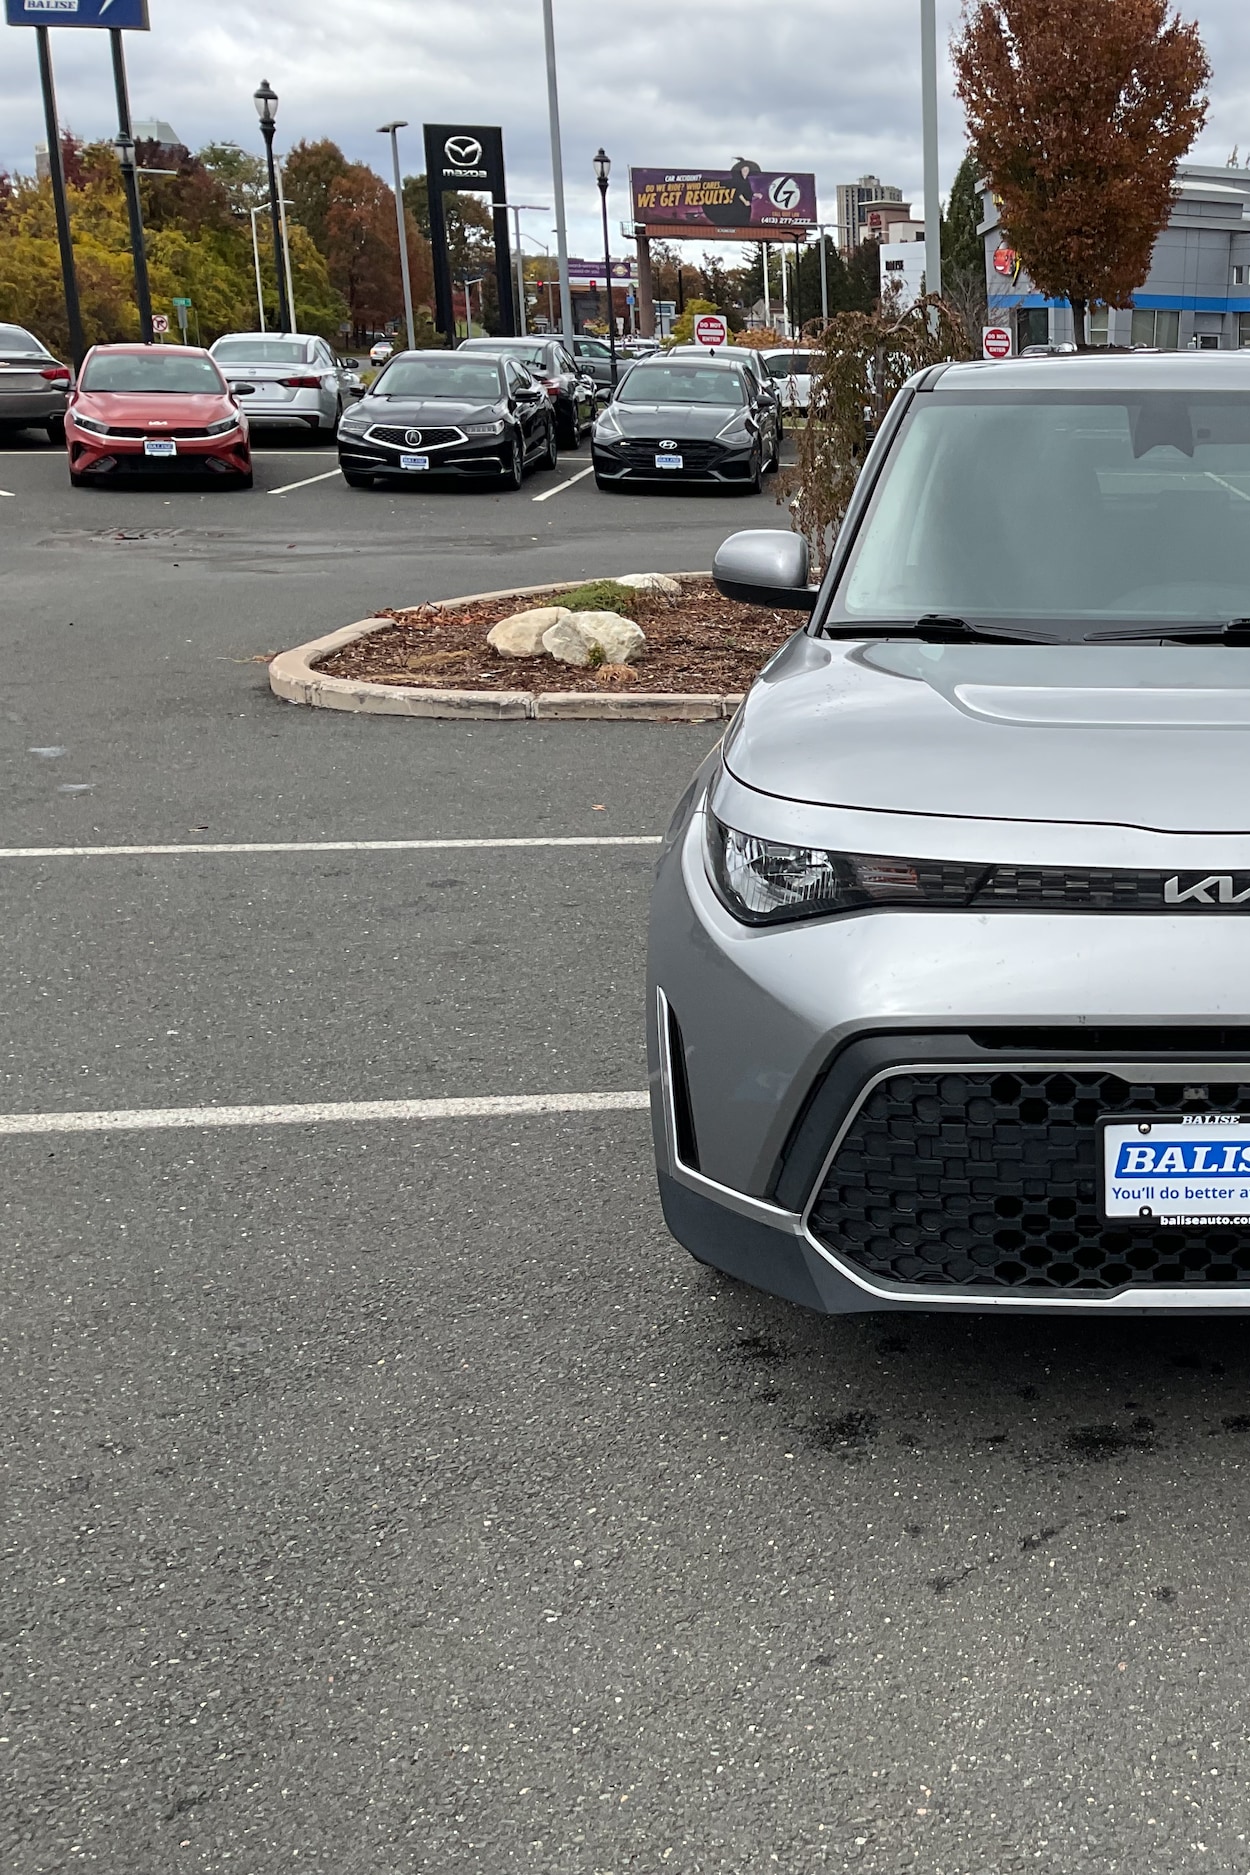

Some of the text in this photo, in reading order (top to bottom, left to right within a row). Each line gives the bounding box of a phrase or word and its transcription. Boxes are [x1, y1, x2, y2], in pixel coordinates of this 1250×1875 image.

[26, 0, 76, 9] BALISE
[637, 188, 736, 208] WE GET RESULTS!
[1181, 1115, 1241, 1125] BALISE
[1112, 1186, 1154, 1199] You'll
[1160, 1186, 1179, 1199] do
[1185, 1185, 1235, 1199] better
